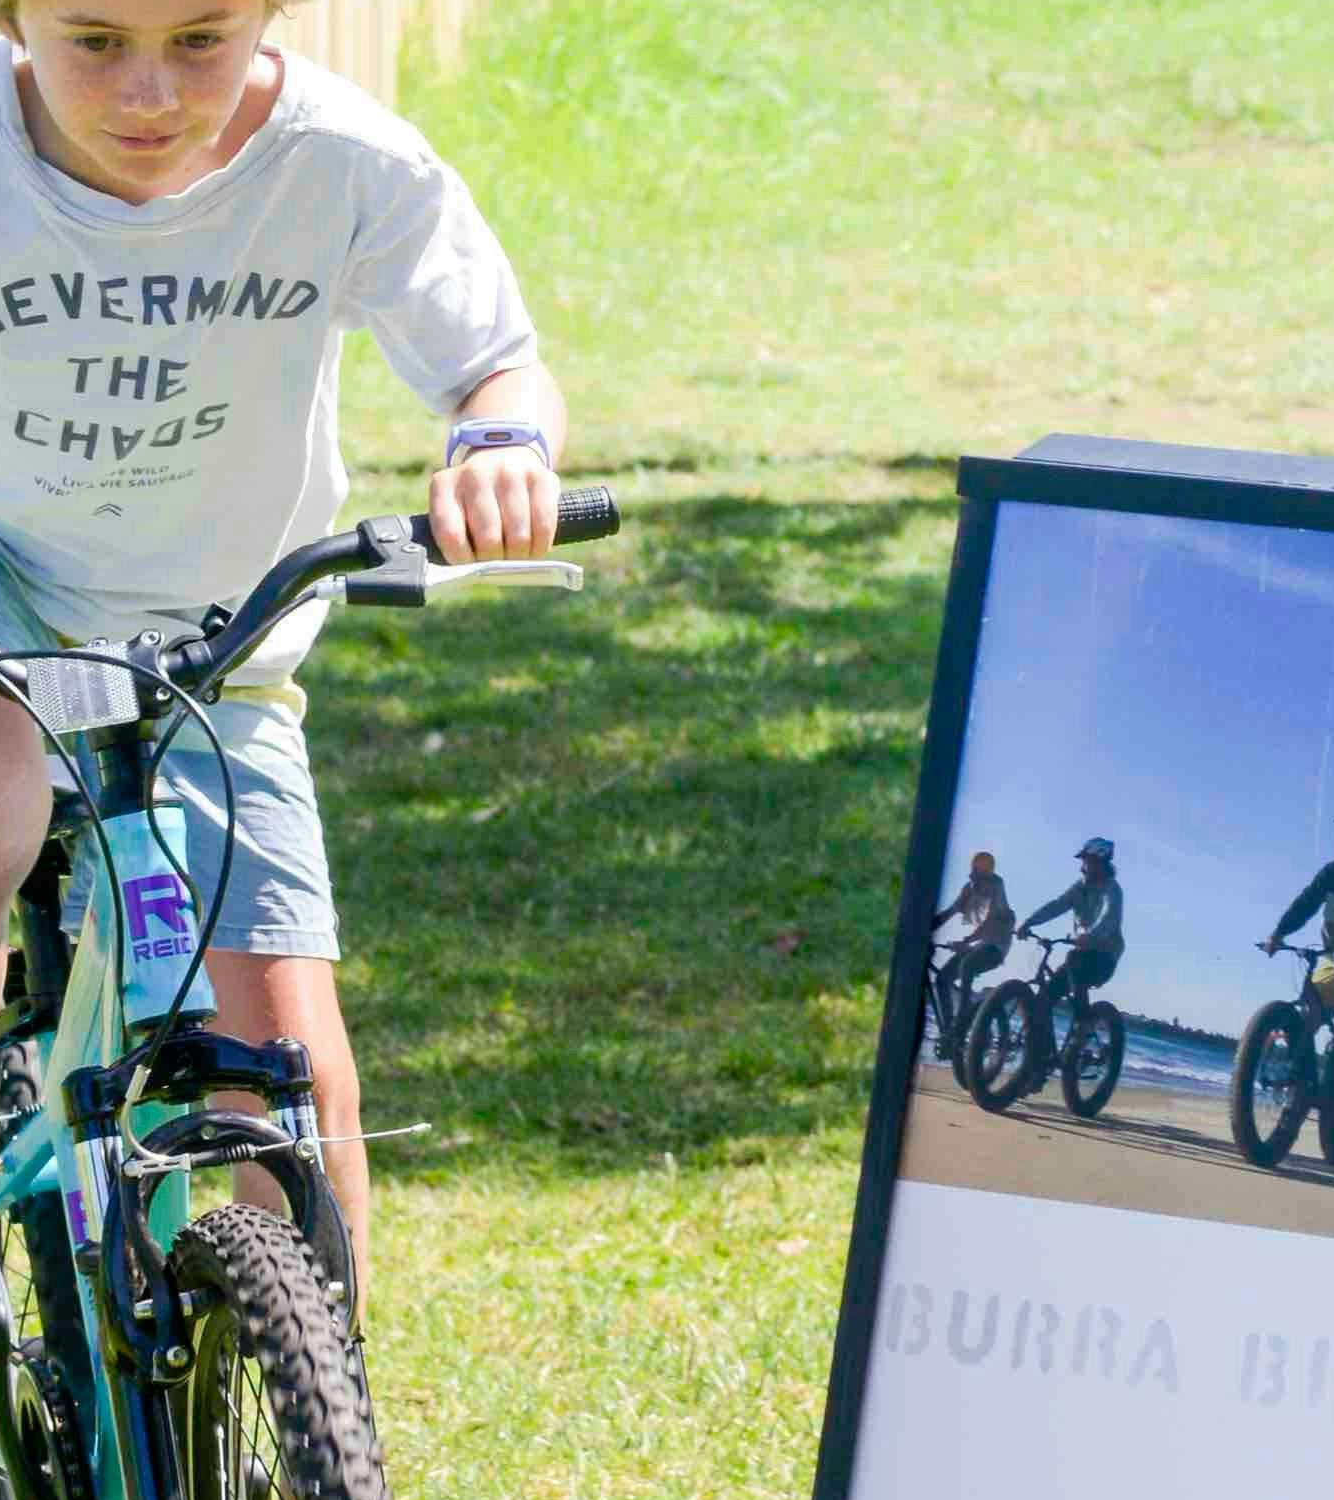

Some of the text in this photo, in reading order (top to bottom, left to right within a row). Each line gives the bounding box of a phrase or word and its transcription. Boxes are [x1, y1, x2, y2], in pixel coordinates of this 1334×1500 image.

[67, 356, 190, 402] THE
[15, 402, 230, 461] CHAOS
[884, 1283, 1178, 1394] BURRA
